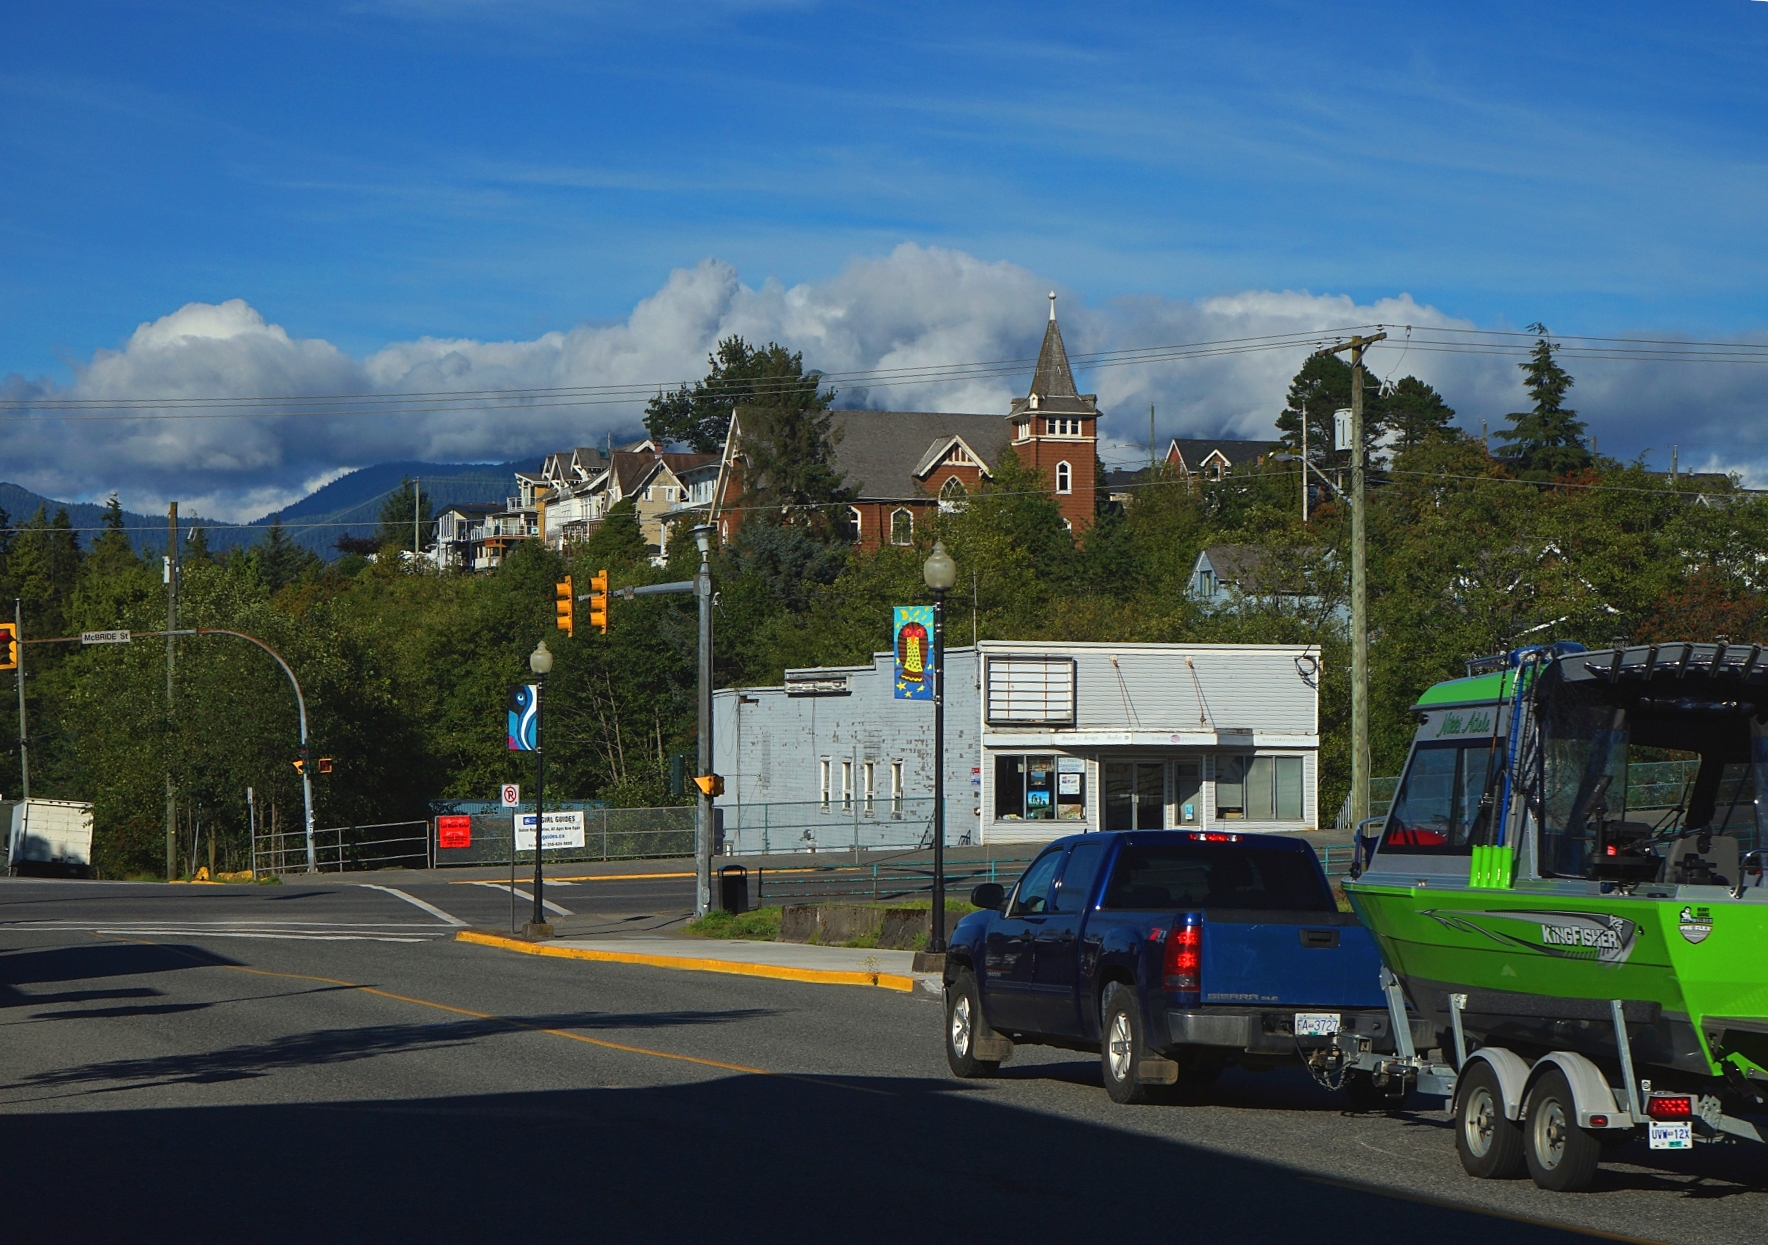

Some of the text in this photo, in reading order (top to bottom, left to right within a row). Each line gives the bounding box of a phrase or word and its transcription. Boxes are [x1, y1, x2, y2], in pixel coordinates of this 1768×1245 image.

[84, 632, 129, 641] McBRIDE St
[541, 816, 554, 824] GIRL
[555, 815, 576, 823] GUIDES
[1207, 992, 1259, 1001] SIERRA
